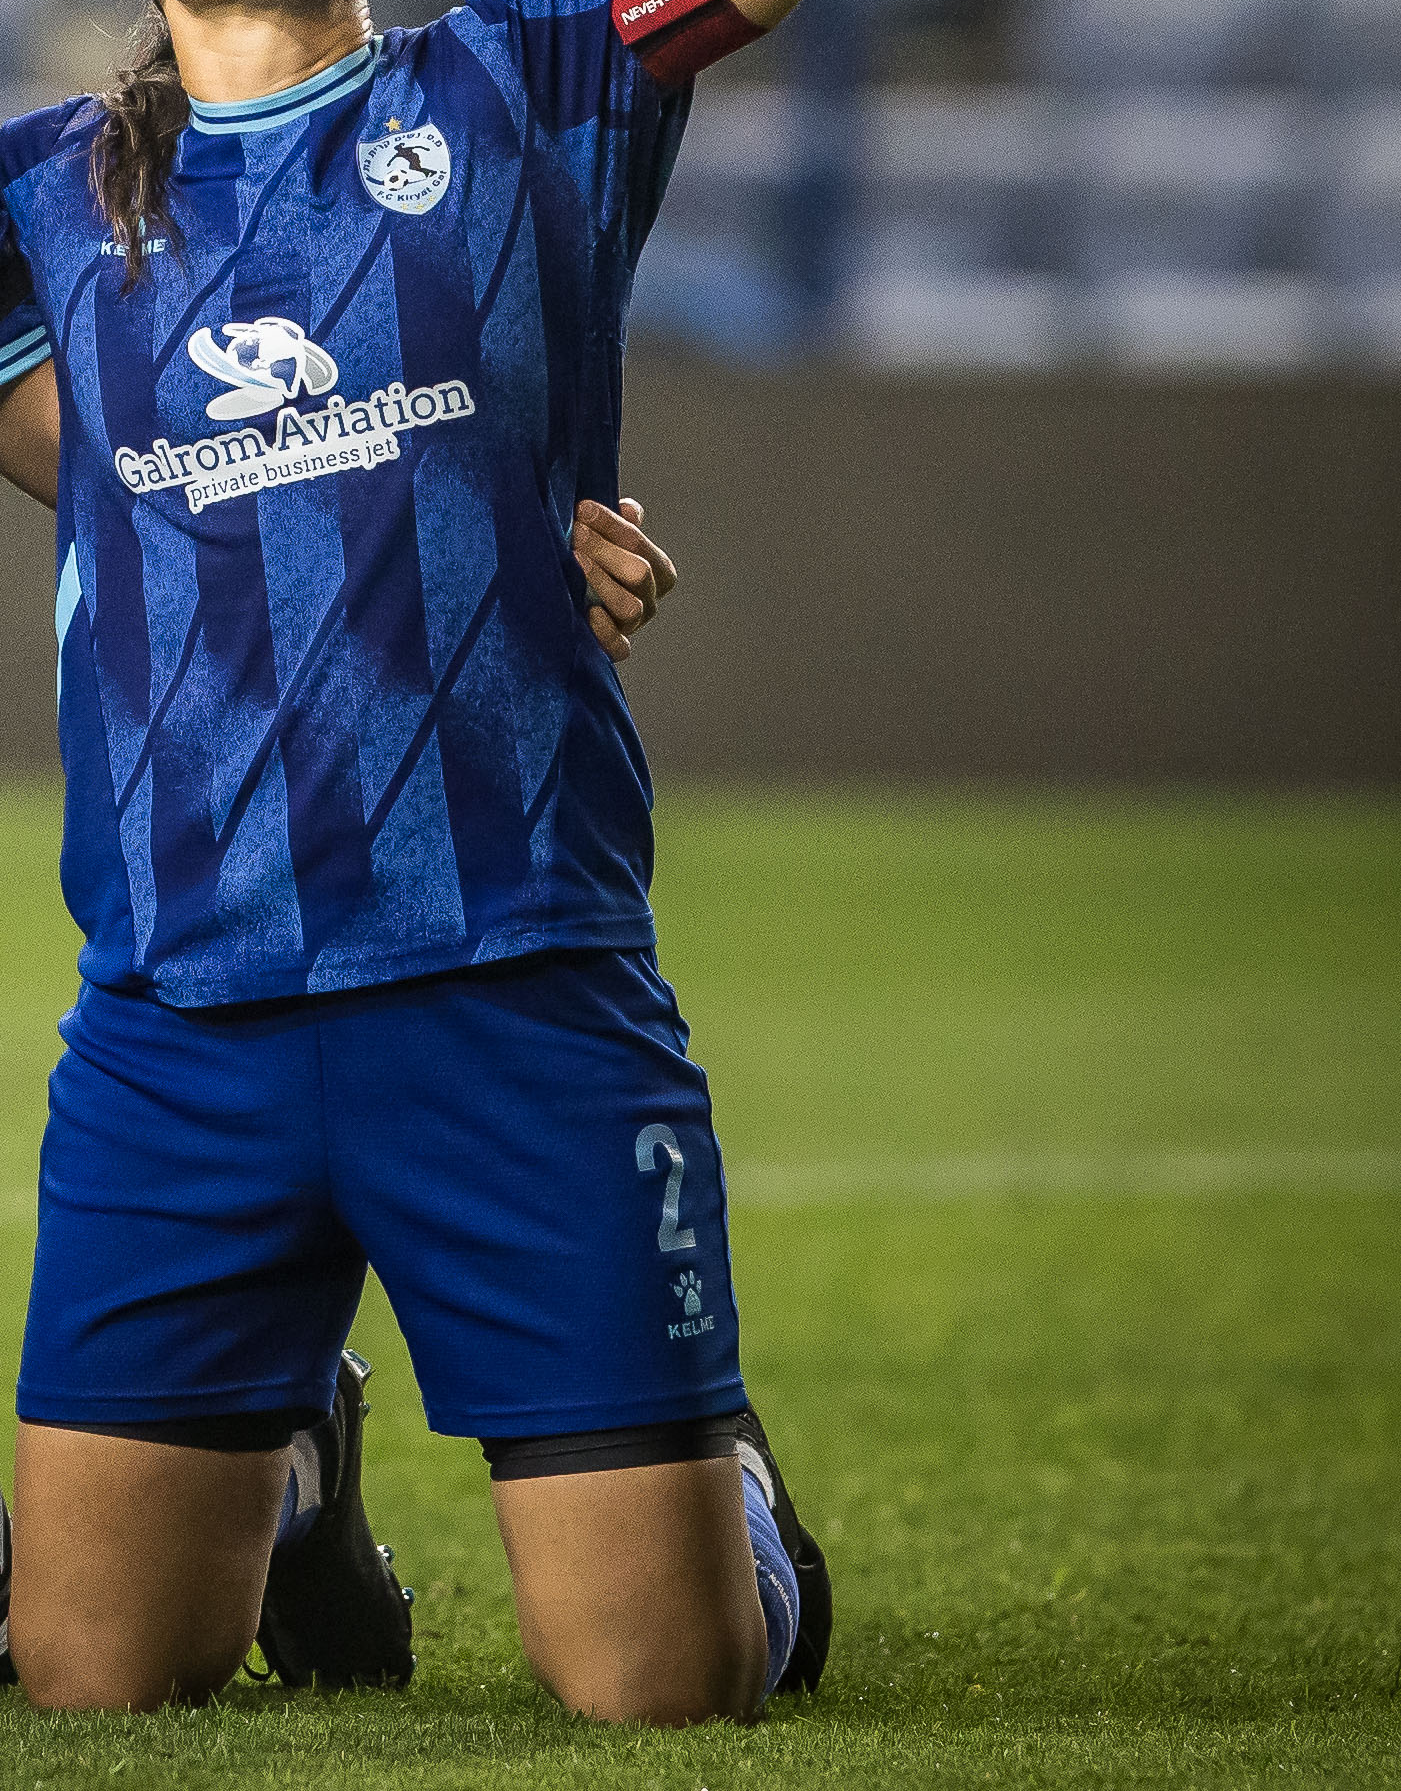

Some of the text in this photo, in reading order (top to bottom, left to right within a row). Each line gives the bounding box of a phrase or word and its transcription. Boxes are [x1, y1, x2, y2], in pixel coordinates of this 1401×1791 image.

[397, 186, 433, 202] Kiryat
[432, 170, 447, 187] Gat
[101, 238, 168, 257] KEME
[117, 385, 471, 488] Galrom Aviation
[190, 441, 395, 505] private business jet
[635, 1123, 696, 1252] 2
[667, 1315, 714, 1340] KELME
